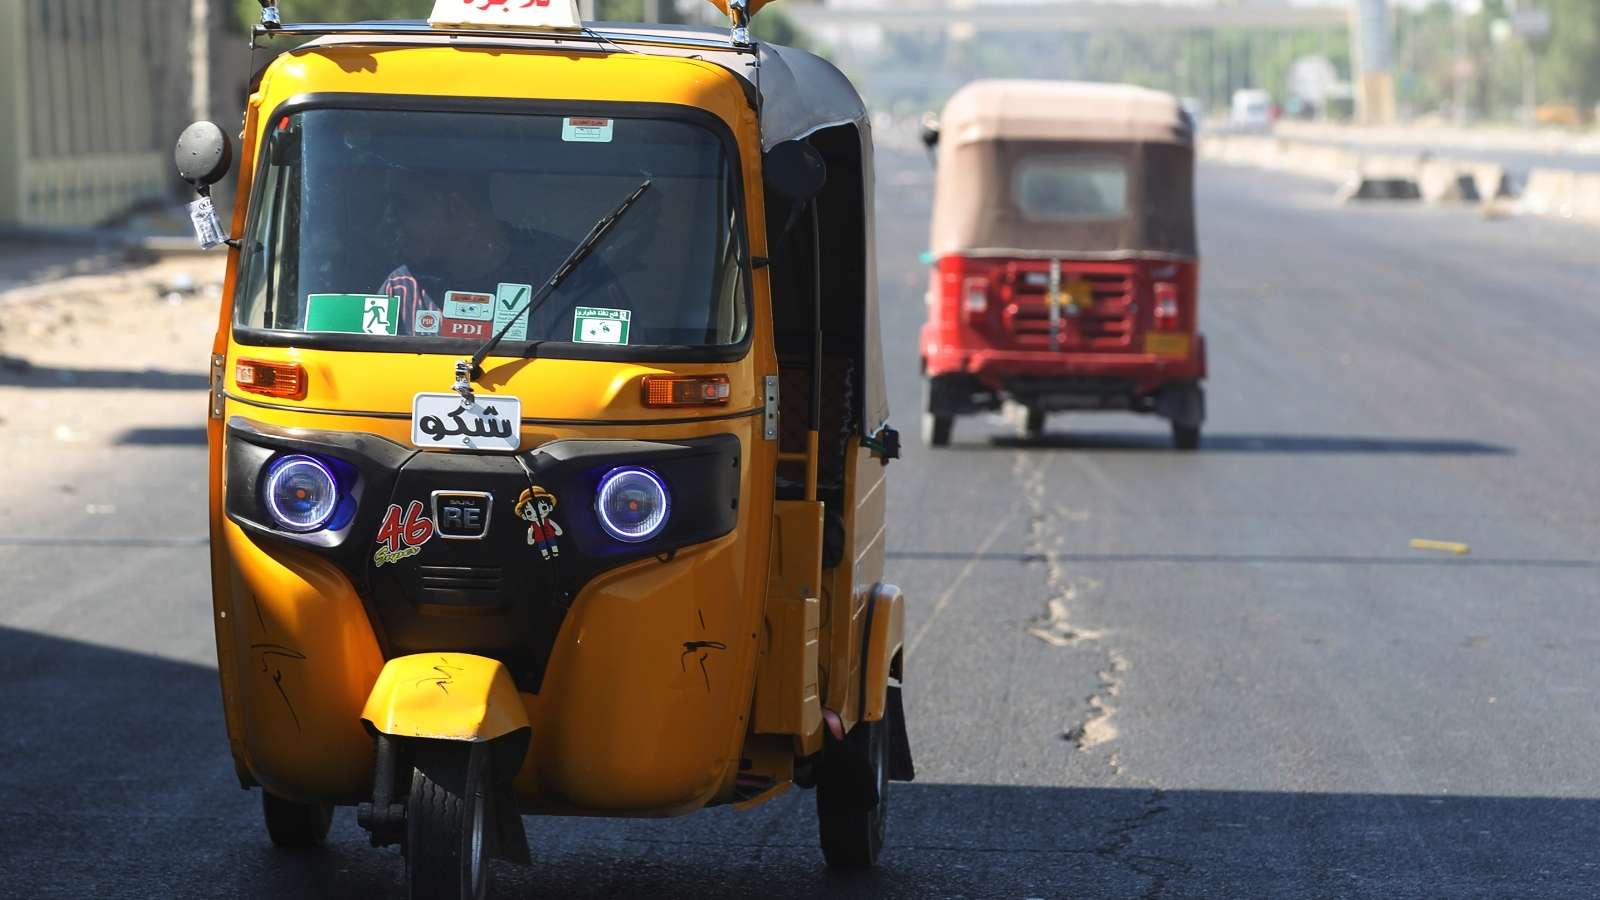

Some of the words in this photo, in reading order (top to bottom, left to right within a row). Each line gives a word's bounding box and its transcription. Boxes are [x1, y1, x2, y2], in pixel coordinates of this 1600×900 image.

[452, 323, 482, 335] PDI
[419, 405, 513, 441] شكو
[376, 500, 434, 553] 46
[443, 507, 481, 529] RE
